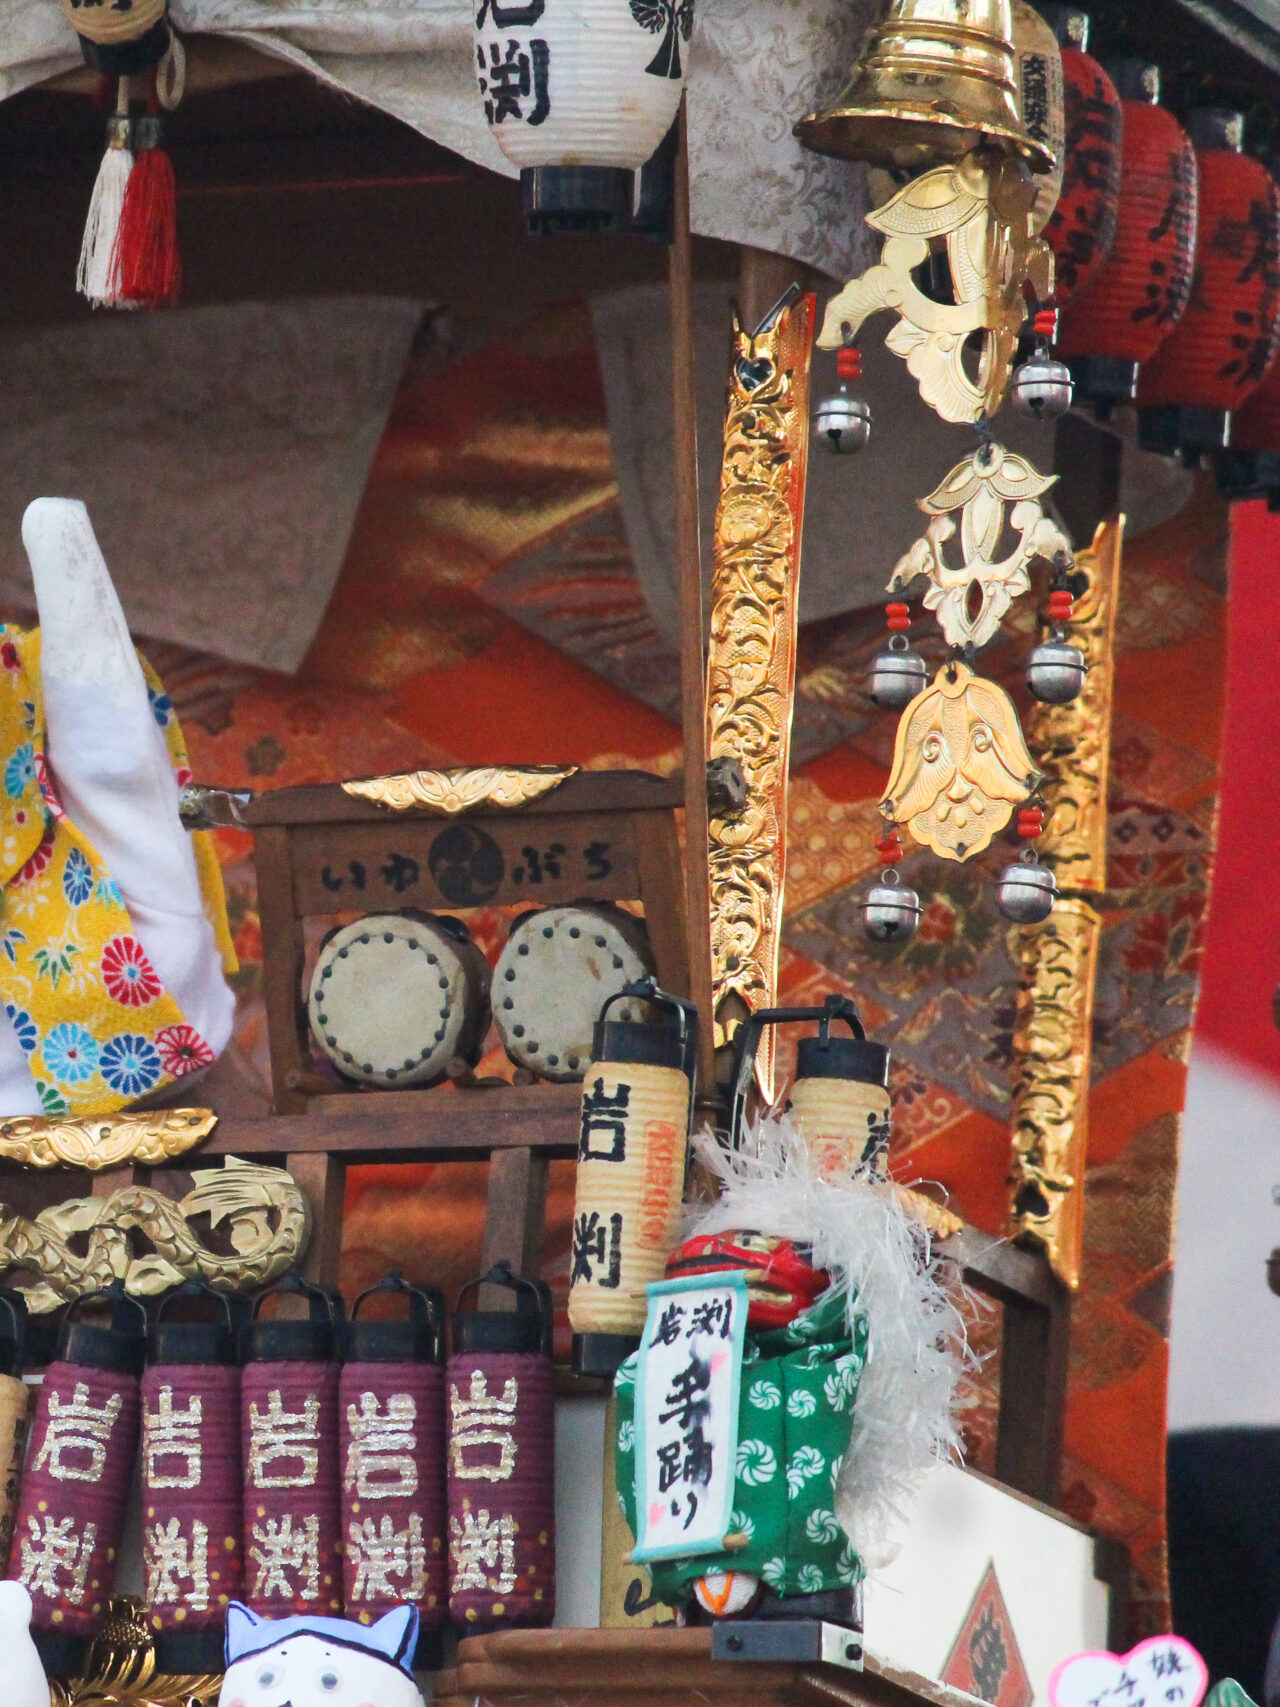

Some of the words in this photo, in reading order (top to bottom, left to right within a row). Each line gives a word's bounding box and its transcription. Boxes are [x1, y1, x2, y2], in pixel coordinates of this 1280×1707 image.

[649, 1293, 733, 1349] 岩渕
[658, 1358, 713, 1530] 手踊り
